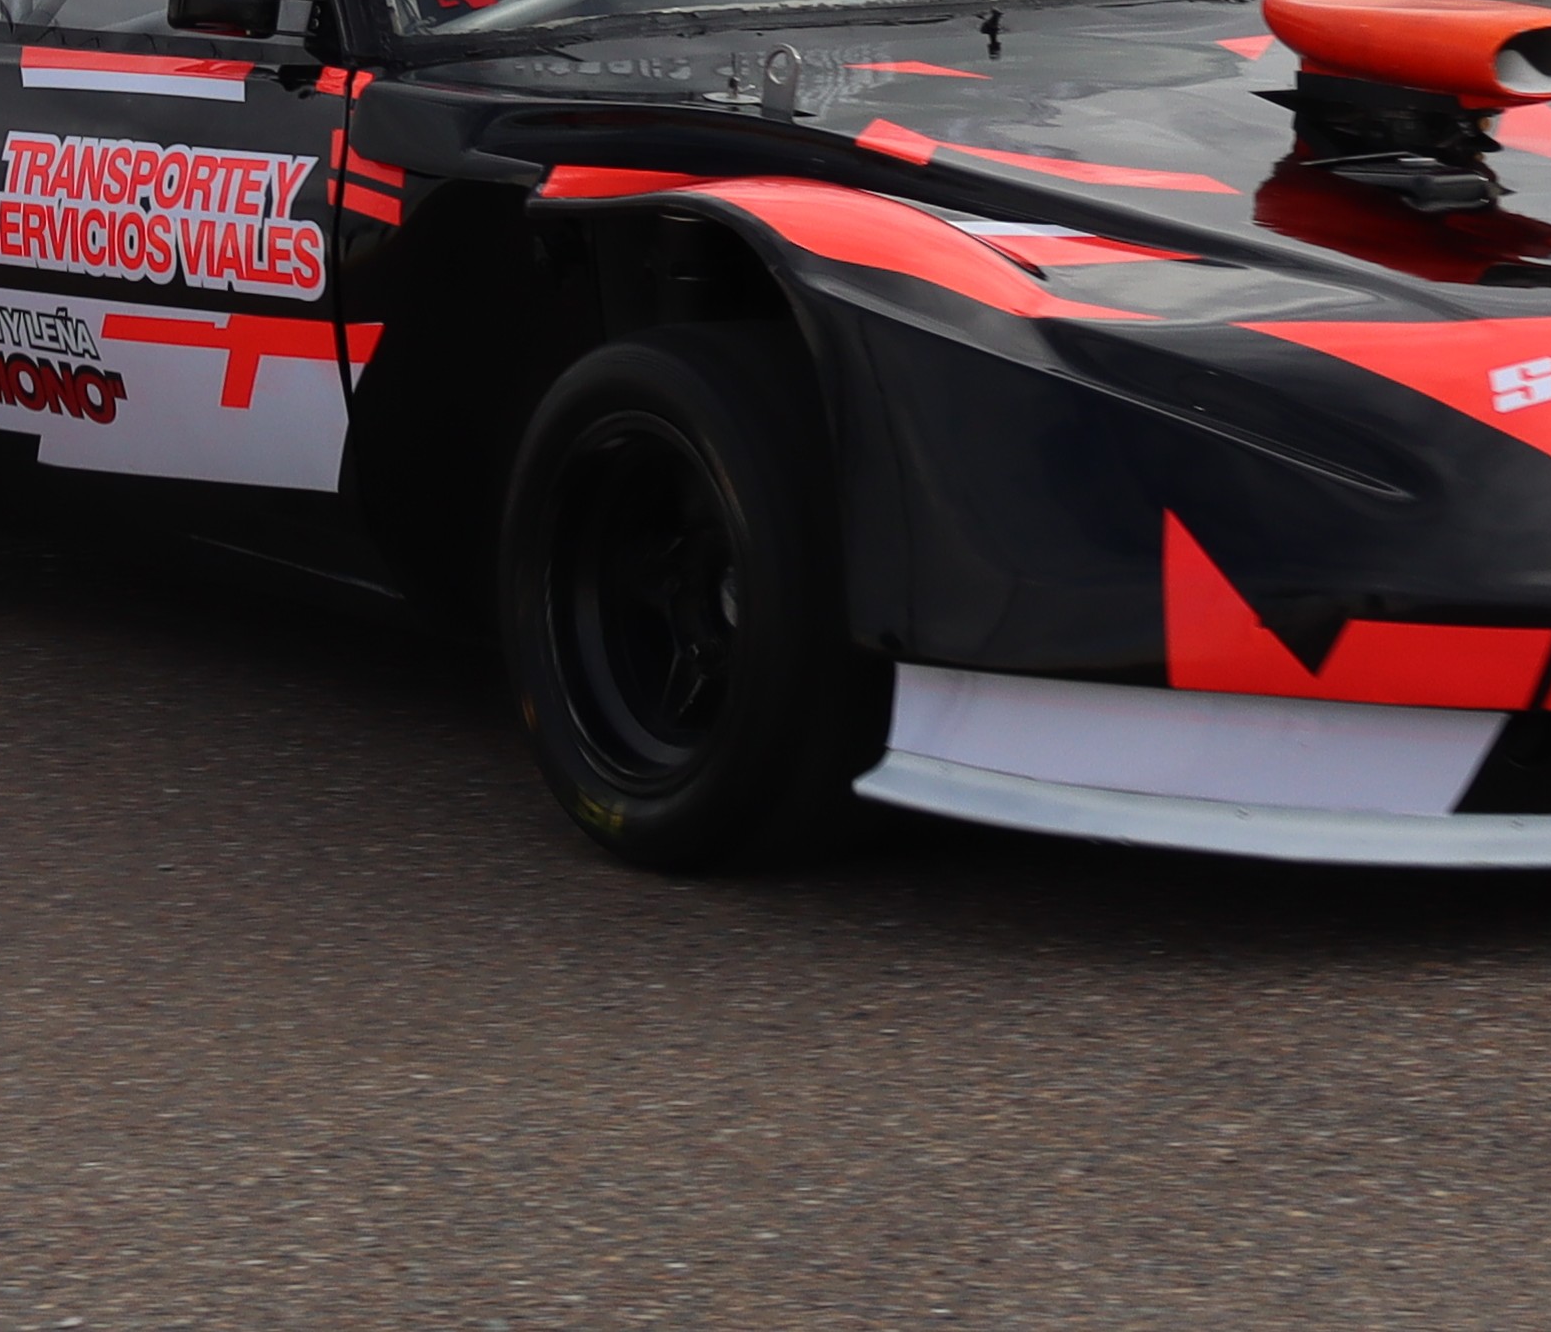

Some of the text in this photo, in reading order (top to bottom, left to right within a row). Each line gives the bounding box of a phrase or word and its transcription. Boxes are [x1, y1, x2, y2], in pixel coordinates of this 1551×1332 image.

[4, 133, 315, 220] TRANSPORTE Y
[178, 215, 323, 293] VIALES
[21, 304, 101, 361] LEÑA
